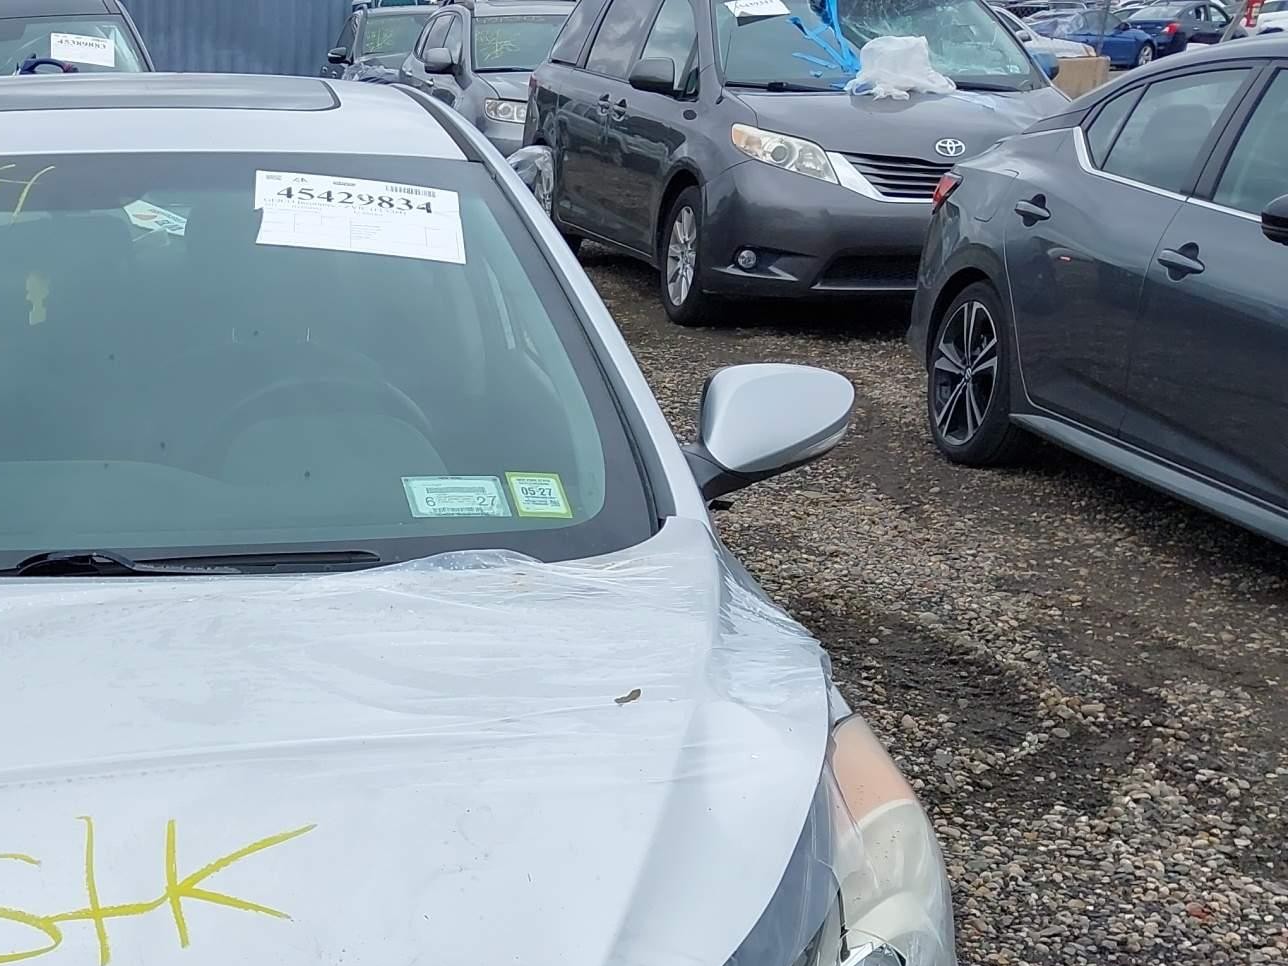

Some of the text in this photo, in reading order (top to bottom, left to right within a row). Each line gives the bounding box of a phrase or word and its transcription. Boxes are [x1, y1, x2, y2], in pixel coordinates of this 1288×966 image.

[277, 186, 433, 214] 45429834
[425, 496, 437, 507] 6
[476, 495, 497, 507] 27
